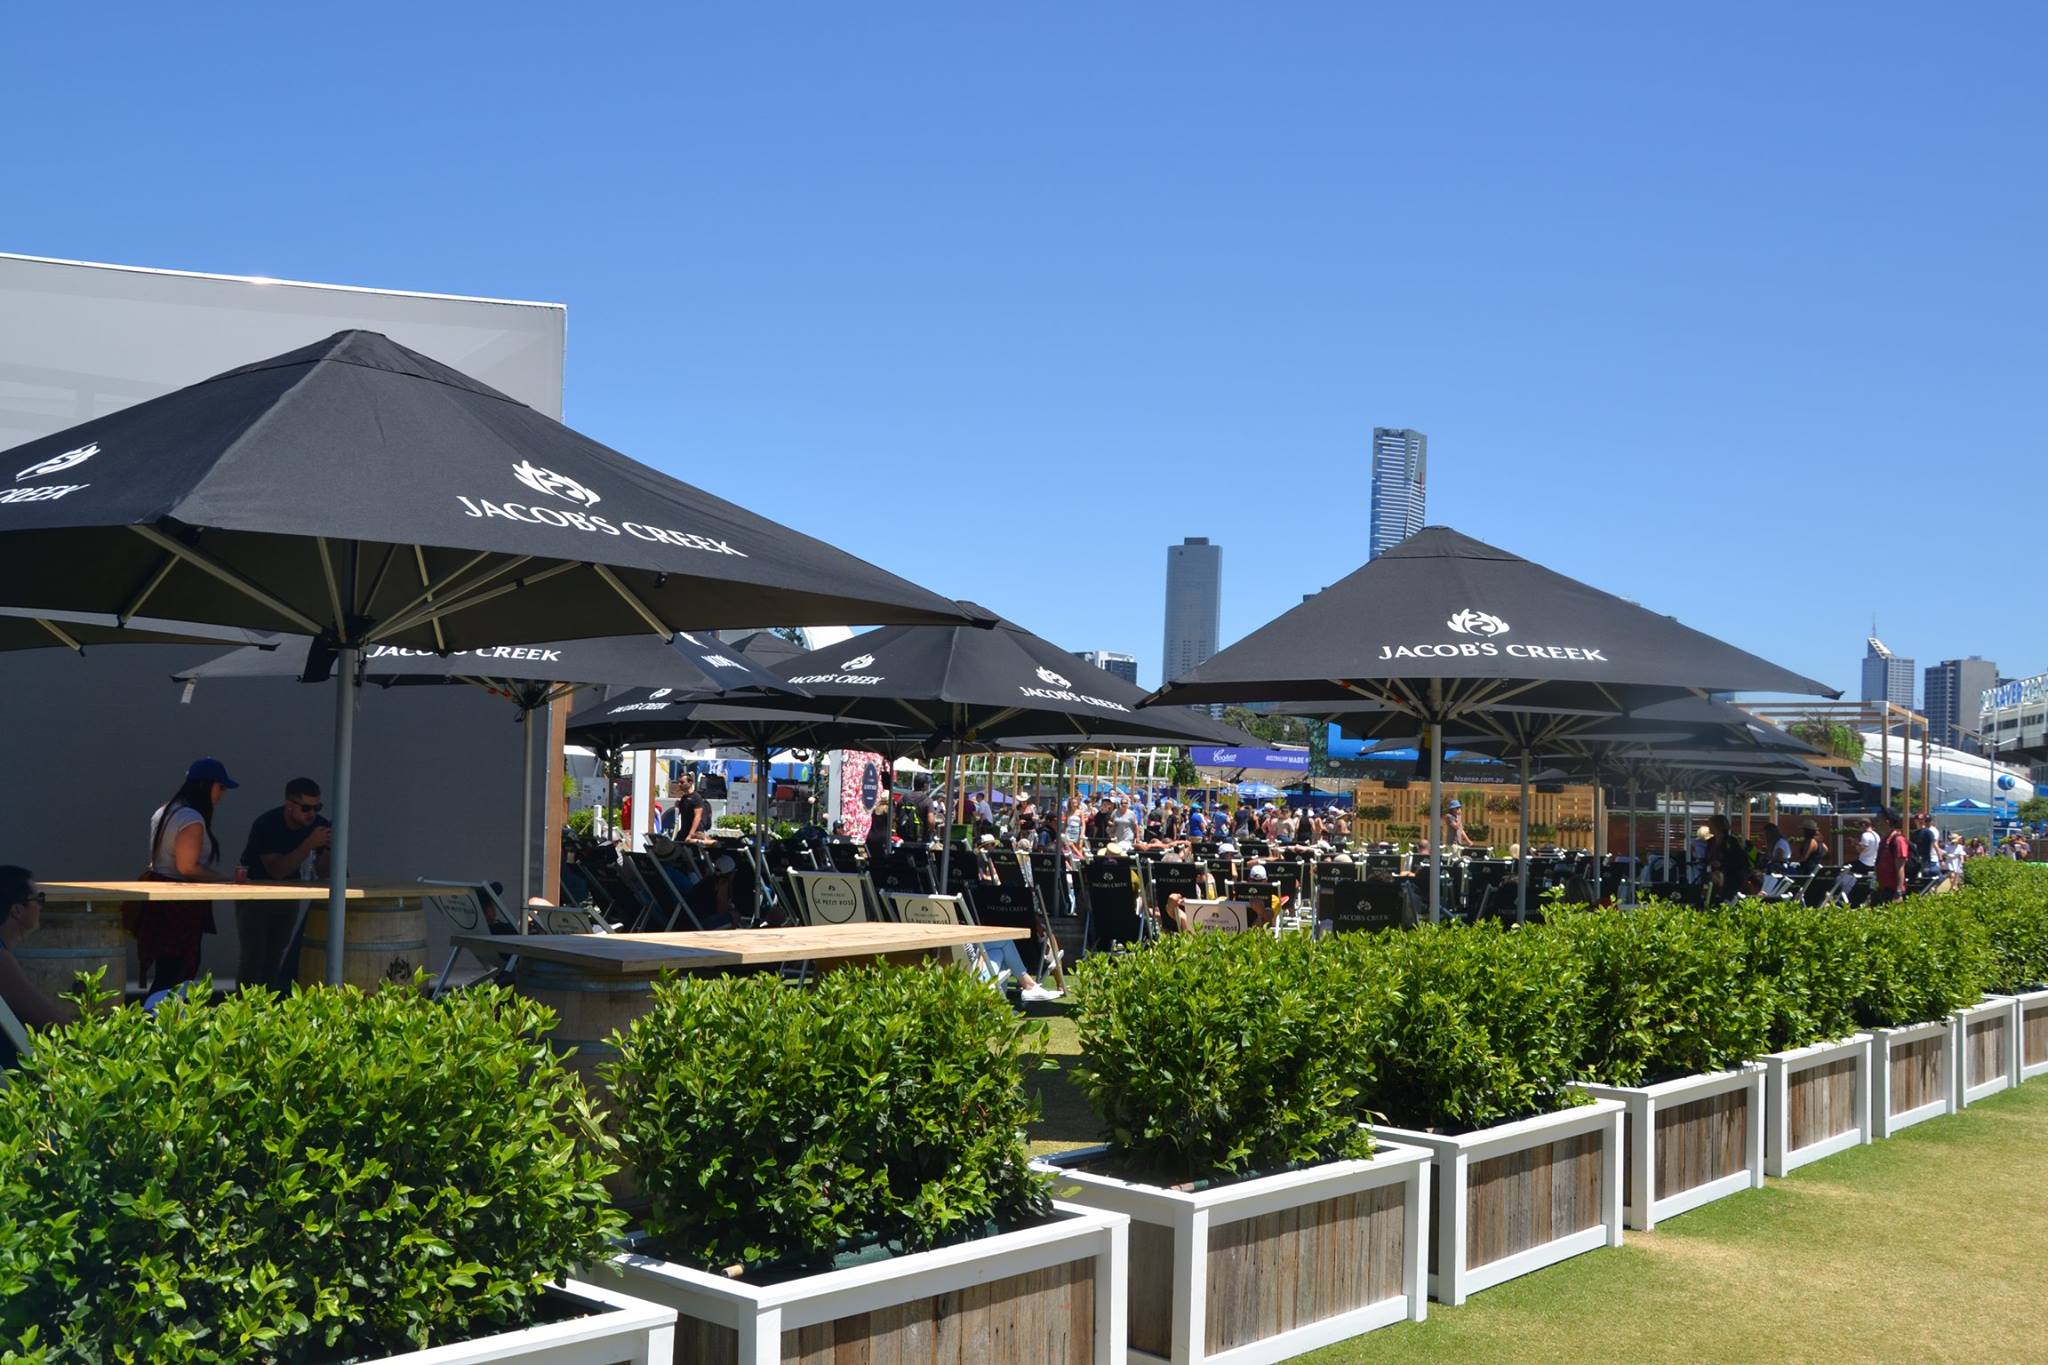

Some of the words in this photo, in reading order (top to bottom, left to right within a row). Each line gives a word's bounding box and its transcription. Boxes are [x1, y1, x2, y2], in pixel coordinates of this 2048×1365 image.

[456, 495, 620, 536] JACOB'S
[622, 521, 749, 558] CREEK
[475, 646, 562, 662] CREEK
[1378, 642, 1499, 660] JACOB'S
[1505, 644, 1609, 661] CREEK
[834, 675, 886, 685] CREEK
[1019, 686, 1081, 702] JACOB'S
[1080, 695, 1131, 713] CREEK
[1454, 775, 1504, 784] hisense.com.au
